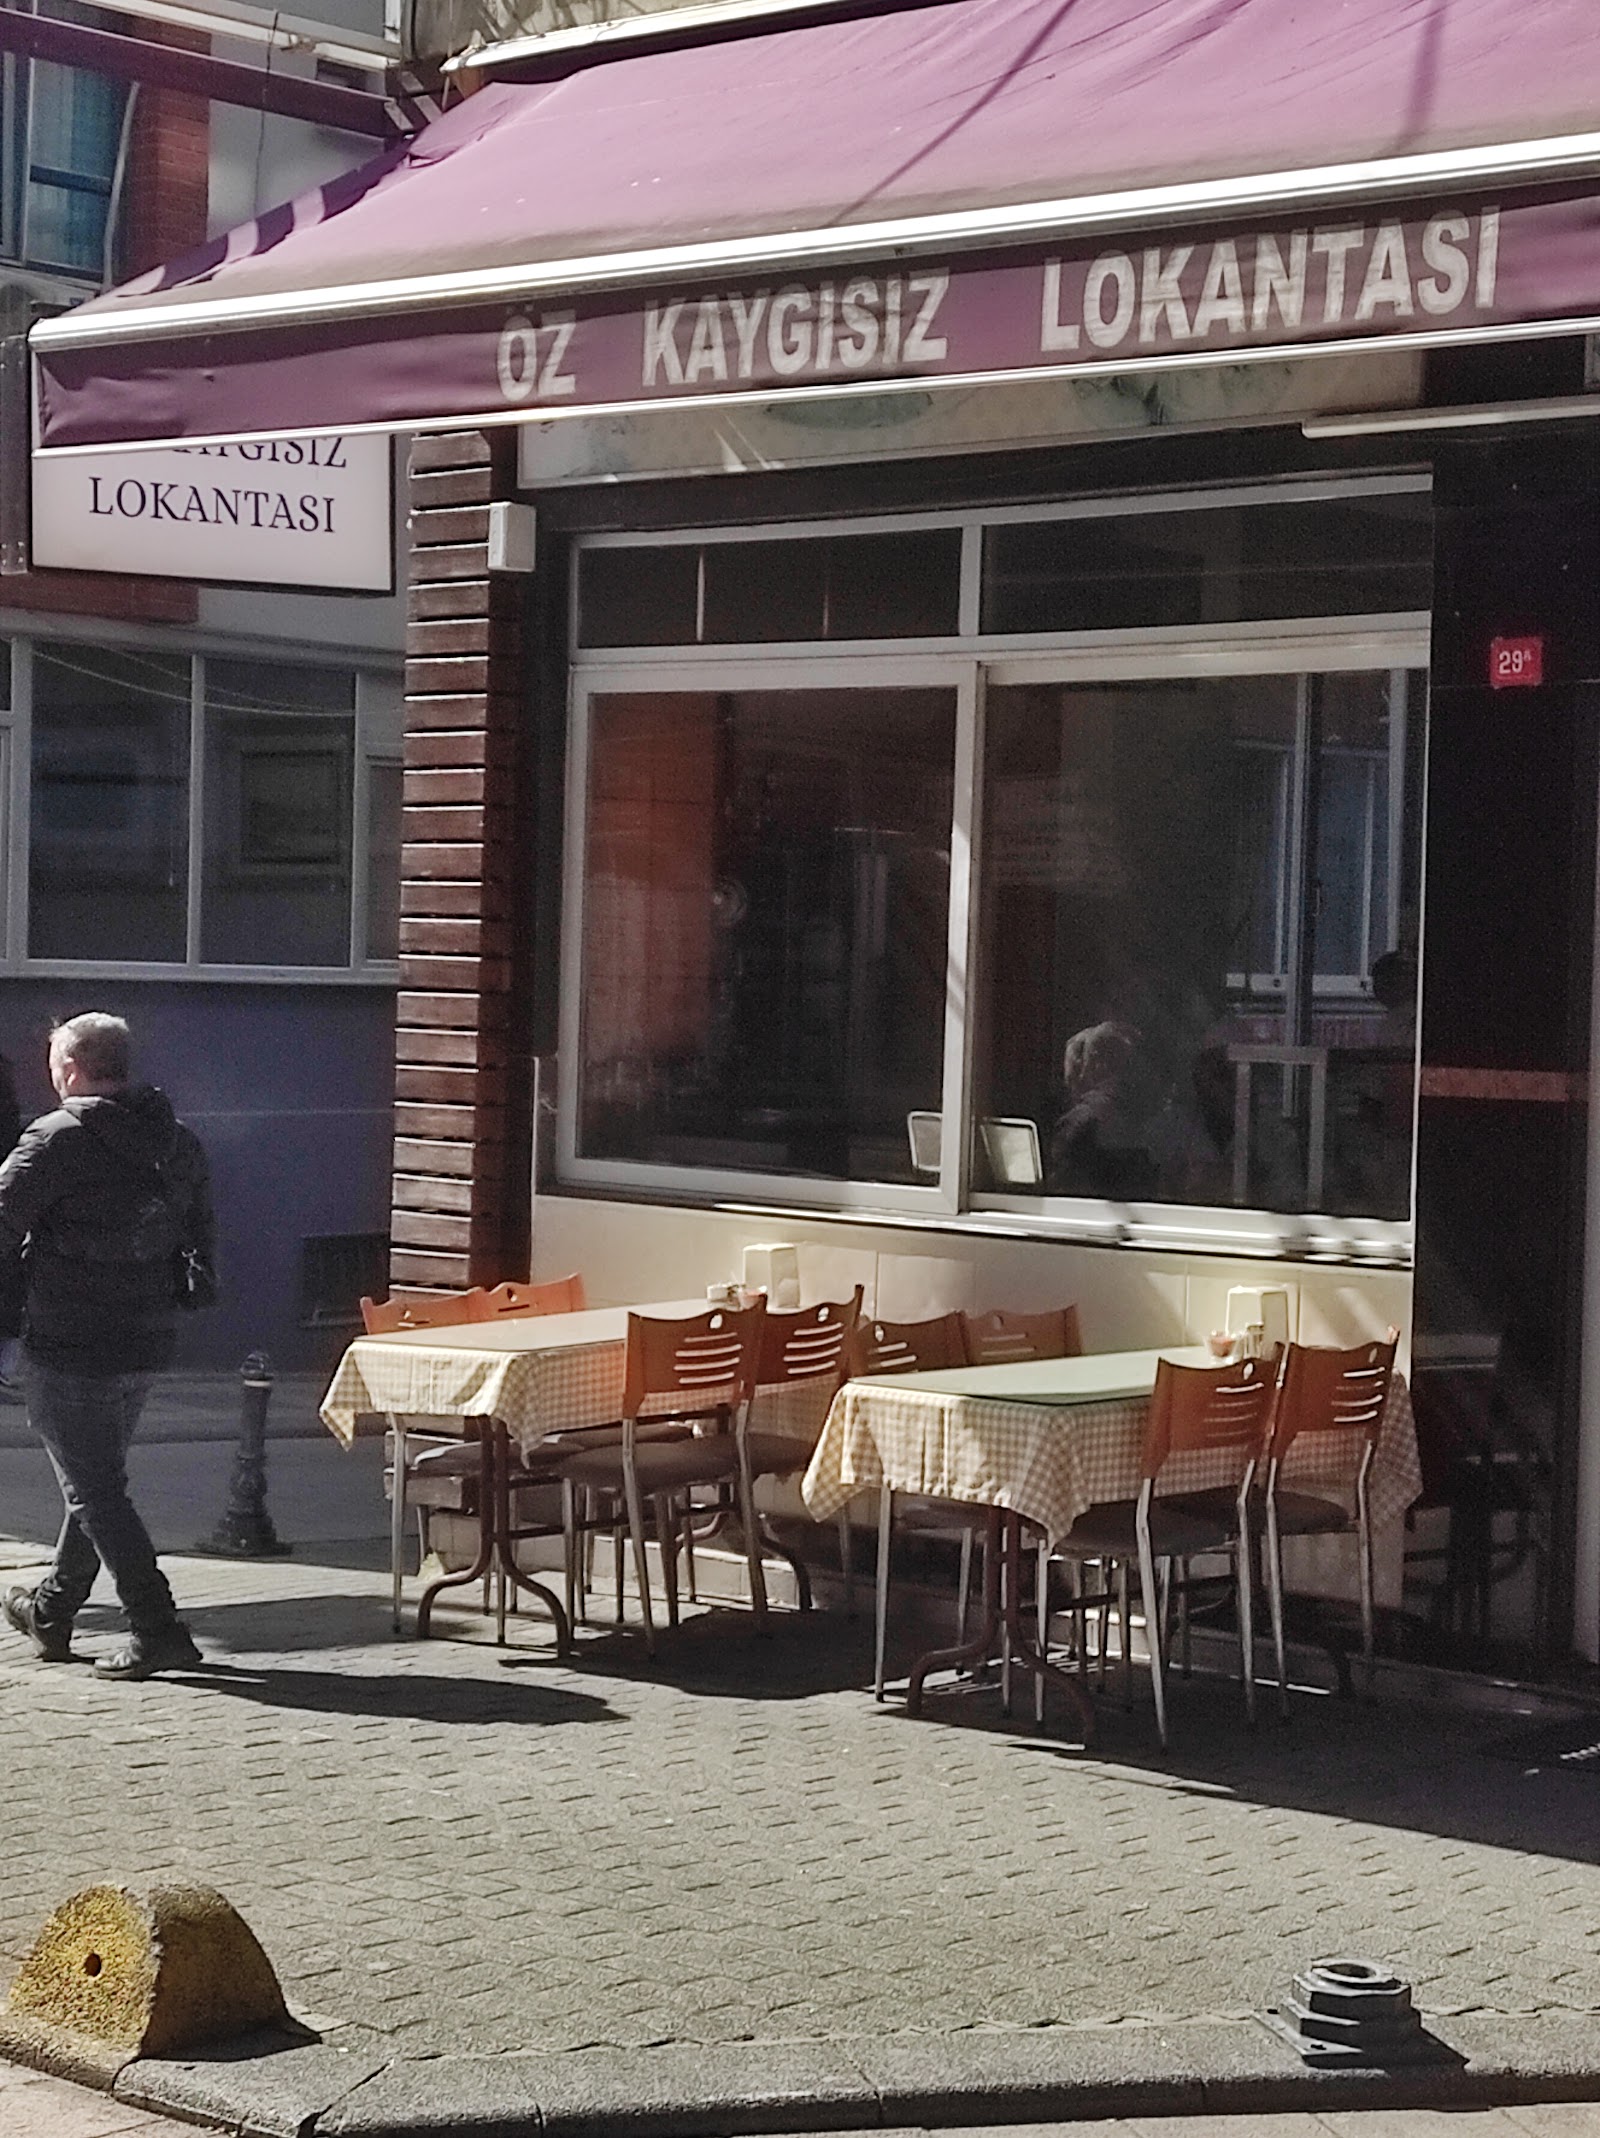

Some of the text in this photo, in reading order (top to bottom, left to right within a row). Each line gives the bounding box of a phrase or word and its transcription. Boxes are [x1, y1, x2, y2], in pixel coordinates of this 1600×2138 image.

[498, 206, 1500, 401] ÖZ KAYGISIZ LOKANTASI
[173, 436, 347, 468] GISIZ
[89, 476, 336, 533] LOKANTASI
